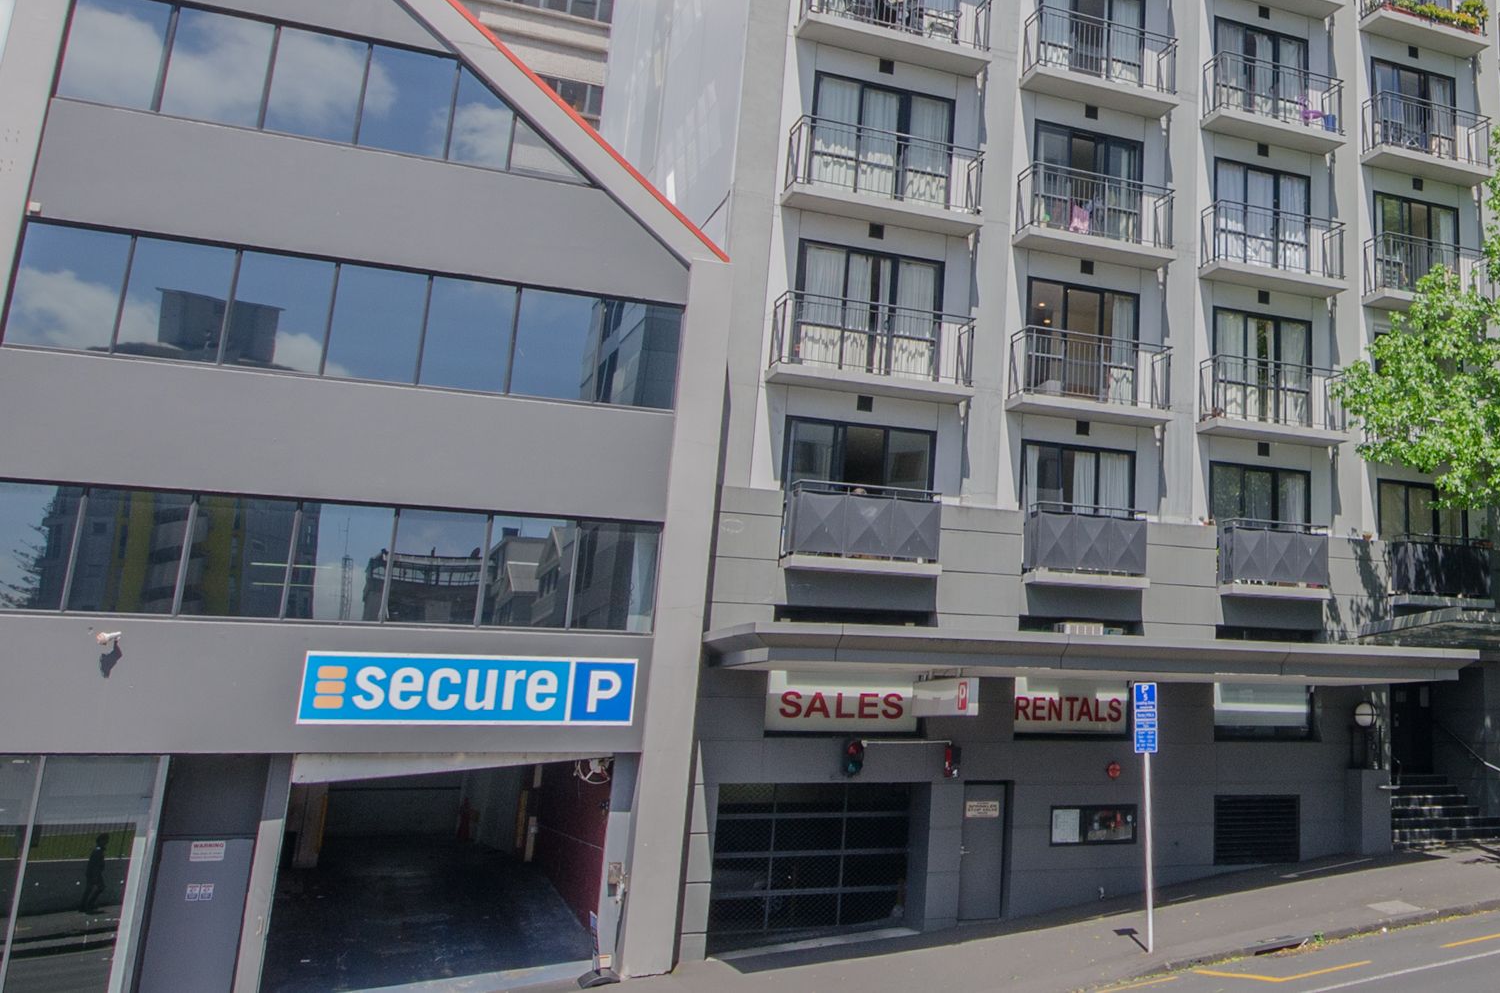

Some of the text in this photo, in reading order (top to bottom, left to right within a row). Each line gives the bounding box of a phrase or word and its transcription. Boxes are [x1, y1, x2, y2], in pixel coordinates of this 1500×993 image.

[351, 665, 622, 713] secure P
[779, 690, 904, 720] SALES
[1014, 695, 1122, 723] RENTALS
